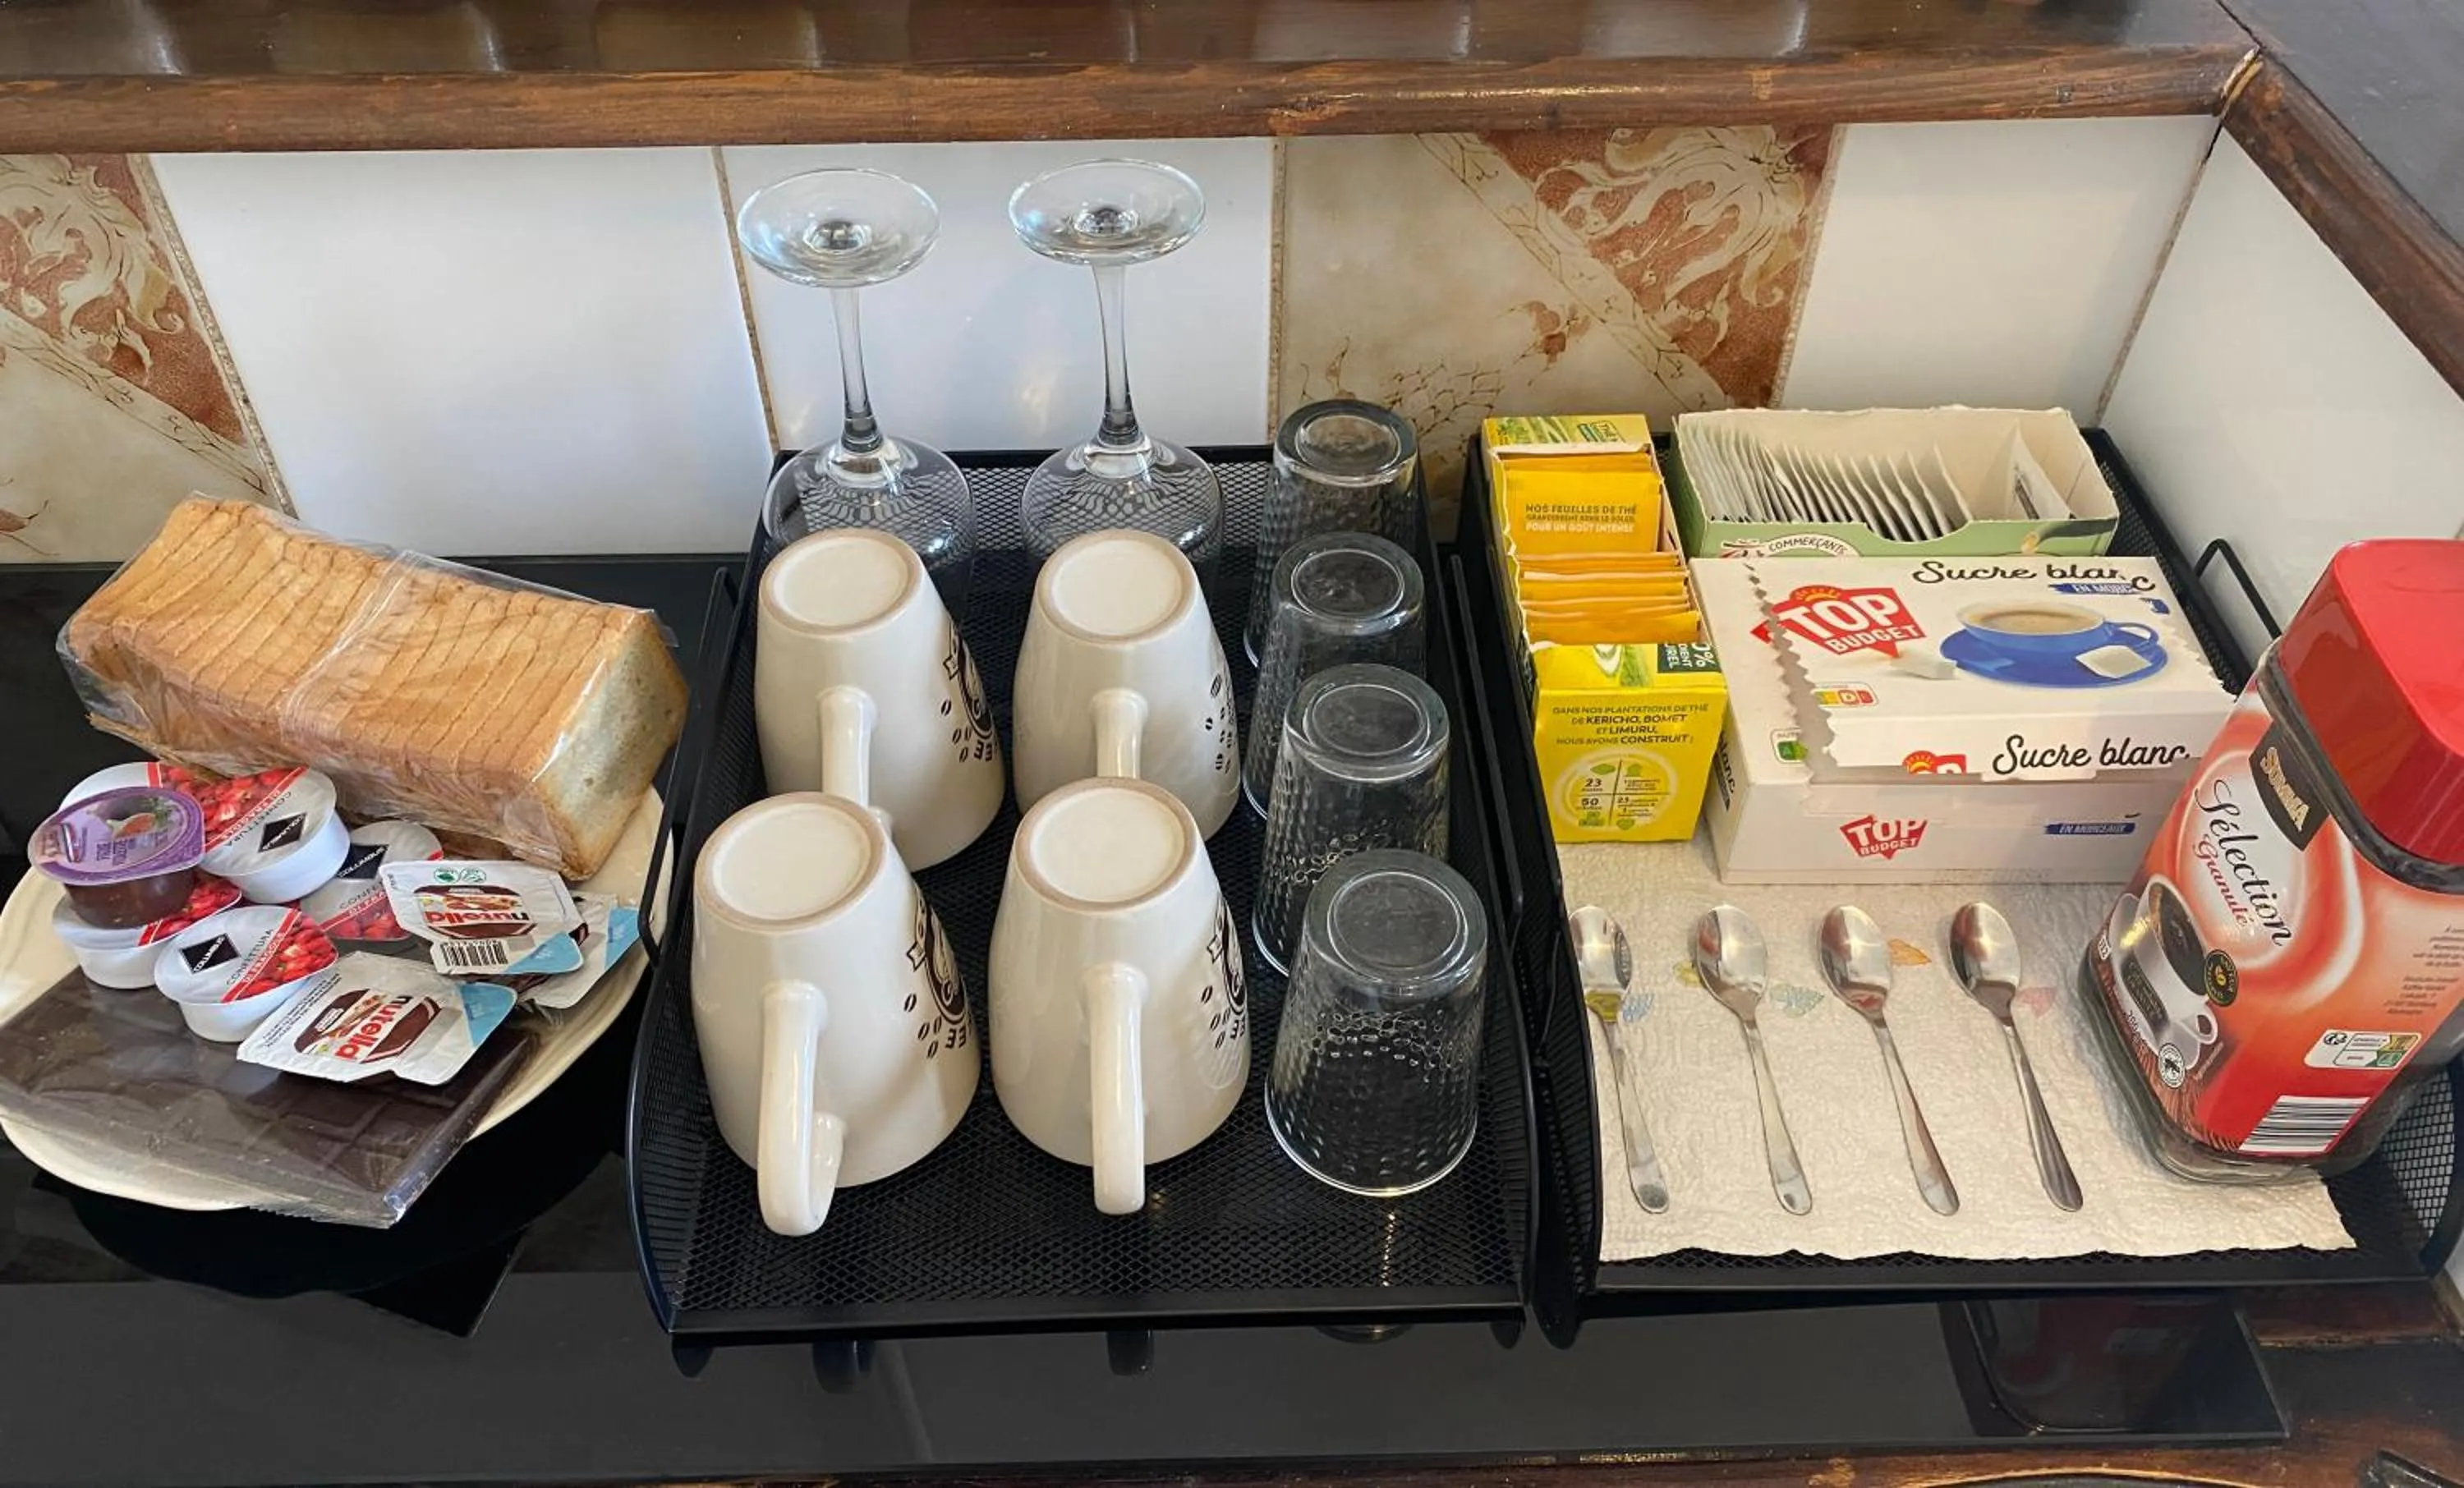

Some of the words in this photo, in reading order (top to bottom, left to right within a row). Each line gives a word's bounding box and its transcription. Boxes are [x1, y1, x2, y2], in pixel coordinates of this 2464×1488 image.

[1912, 561, 2037, 584] Sucre
[1778, 594, 1900, 641] TOP
[1825, 624, 1920, 652] BUDGET
[1602, 705, 1672, 714] PLANTATIONS
[1643, 714, 1689, 724] BOMET
[1993, 733, 2092, 775] Sucre
[1584, 777, 1602, 788] 23
[1580, 797, 1600, 806] 50
[1846, 820, 1928, 847] TOP
[1859, 837, 1919, 857] BUDGET
[2195, 779, 2292, 947] Sélection
[2192, 832, 2255, 927] Granulé
[423, 910, 531, 925] nutella
[334, 994, 415, 1061] nutella
